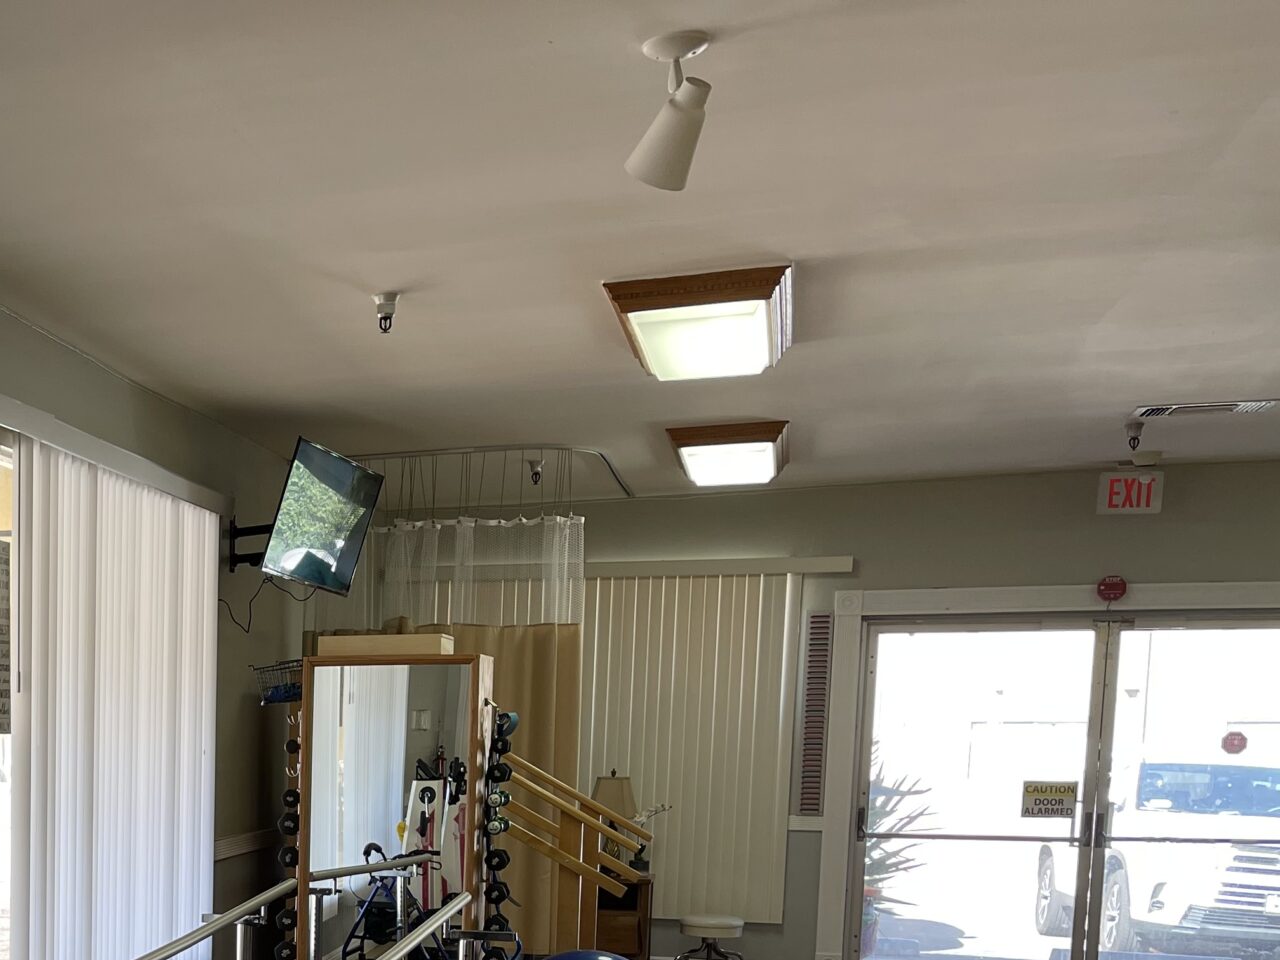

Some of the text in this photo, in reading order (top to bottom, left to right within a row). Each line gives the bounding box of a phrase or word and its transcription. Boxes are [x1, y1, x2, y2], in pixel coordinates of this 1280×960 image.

[1108, 478, 1157, 508] EXIT
[1025, 785, 1075, 794] CAUTION
[1034, 798, 1064, 806] DOOR
[1024, 807, 1073, 816] ALARMED
